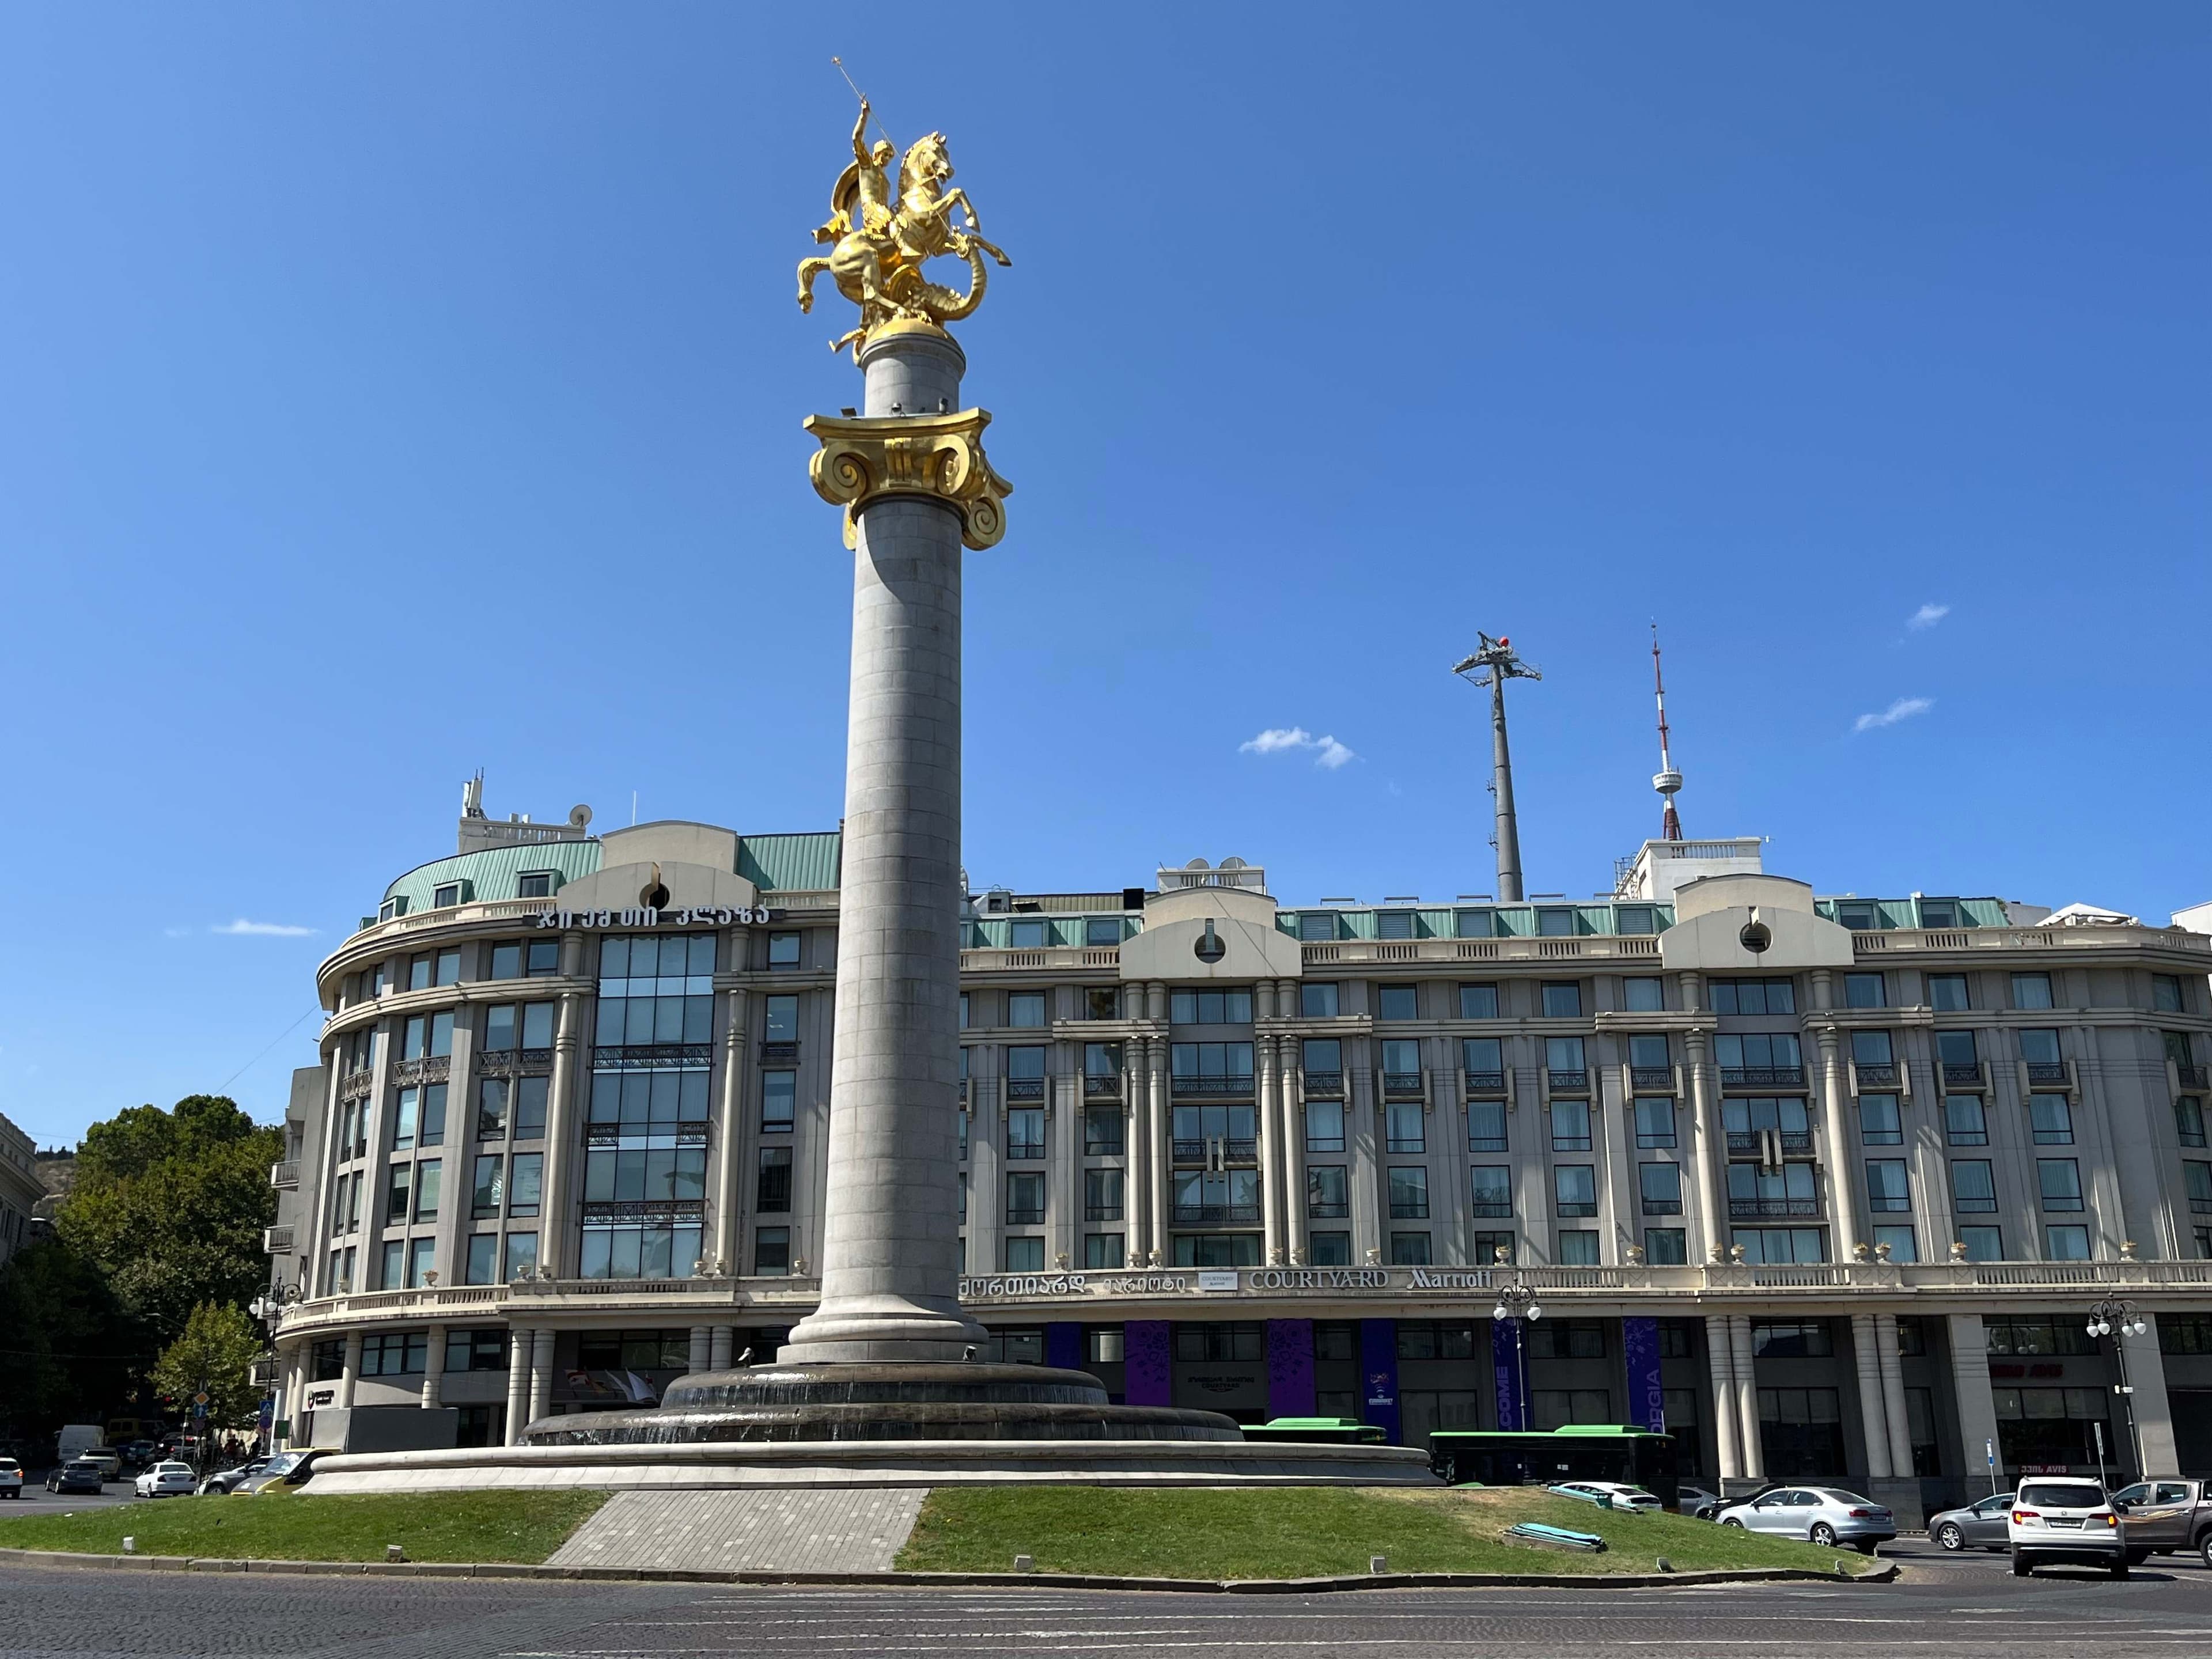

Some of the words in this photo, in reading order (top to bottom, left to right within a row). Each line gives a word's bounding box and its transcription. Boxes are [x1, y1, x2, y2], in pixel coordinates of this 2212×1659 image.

[1103, 1277, 1185, 1293] მარიოტი
[1249, 1270, 1389, 1289] COURTYARD
[1406, 1268, 1491, 1289] Marriott
[1496, 1366, 1513, 1431] COME
[2021, 1465, 2043, 1474] ევის
[2046, 1465, 2067, 1474] AVIS
